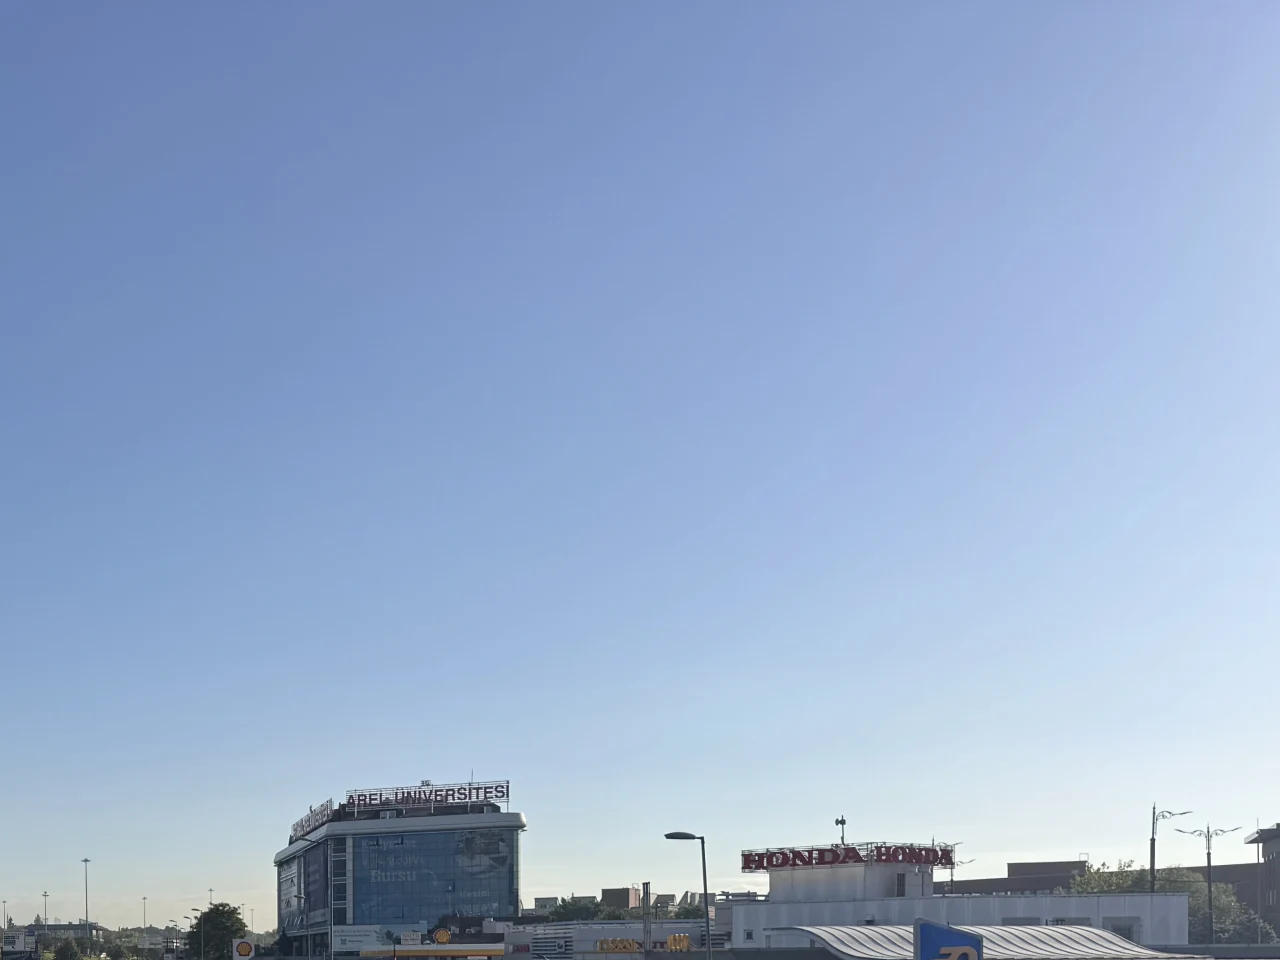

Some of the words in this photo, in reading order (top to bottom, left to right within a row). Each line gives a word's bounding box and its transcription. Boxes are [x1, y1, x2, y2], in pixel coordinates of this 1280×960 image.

[346, 793, 383, 807] AREL
[742, 847, 866, 870] HONDA
[874, 846, 954, 866] HONDA
